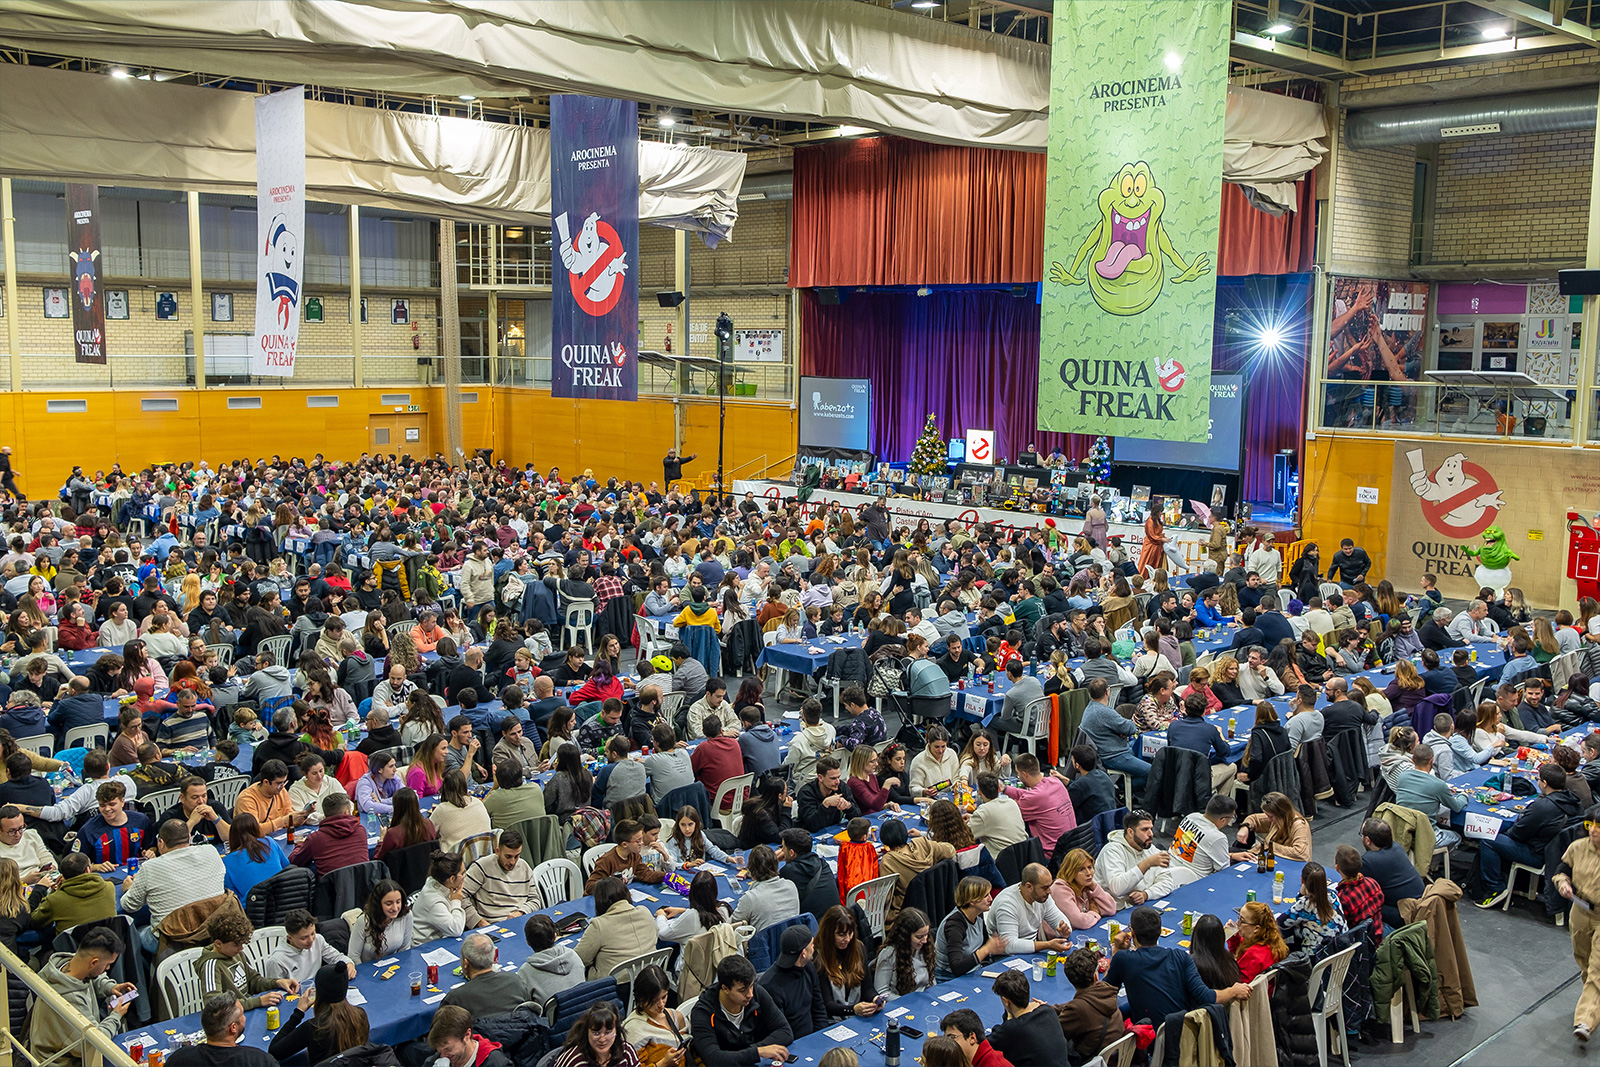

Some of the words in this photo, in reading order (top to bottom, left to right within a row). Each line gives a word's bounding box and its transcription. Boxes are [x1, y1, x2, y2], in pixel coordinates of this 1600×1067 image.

[1090, 75, 1182, 99] AROCINEMA
[1104, 95, 1166, 112] PRESENTA
[570, 145, 617, 161] AROCINEMA
[578, 159, 610, 171] PRESENTA
[76, 330, 96, 345] QUINA
[261, 334, 289, 352] QUINA
[81, 343, 101, 356] FREAK
[561, 344, 612, 369] QUINA
[572, 366, 623, 387] FREAK
[1059, 358, 1153, 392] QUINA
[1210, 384, 1231, 392] QUINA
[1078, 389, 1177, 421] FREAK
[1131, 535, 1144, 543] Pla
[1412, 541, 1472, 561] QUINA
[966, 703, 976, 711] FILA
[1465, 824, 1482, 833] FILA
